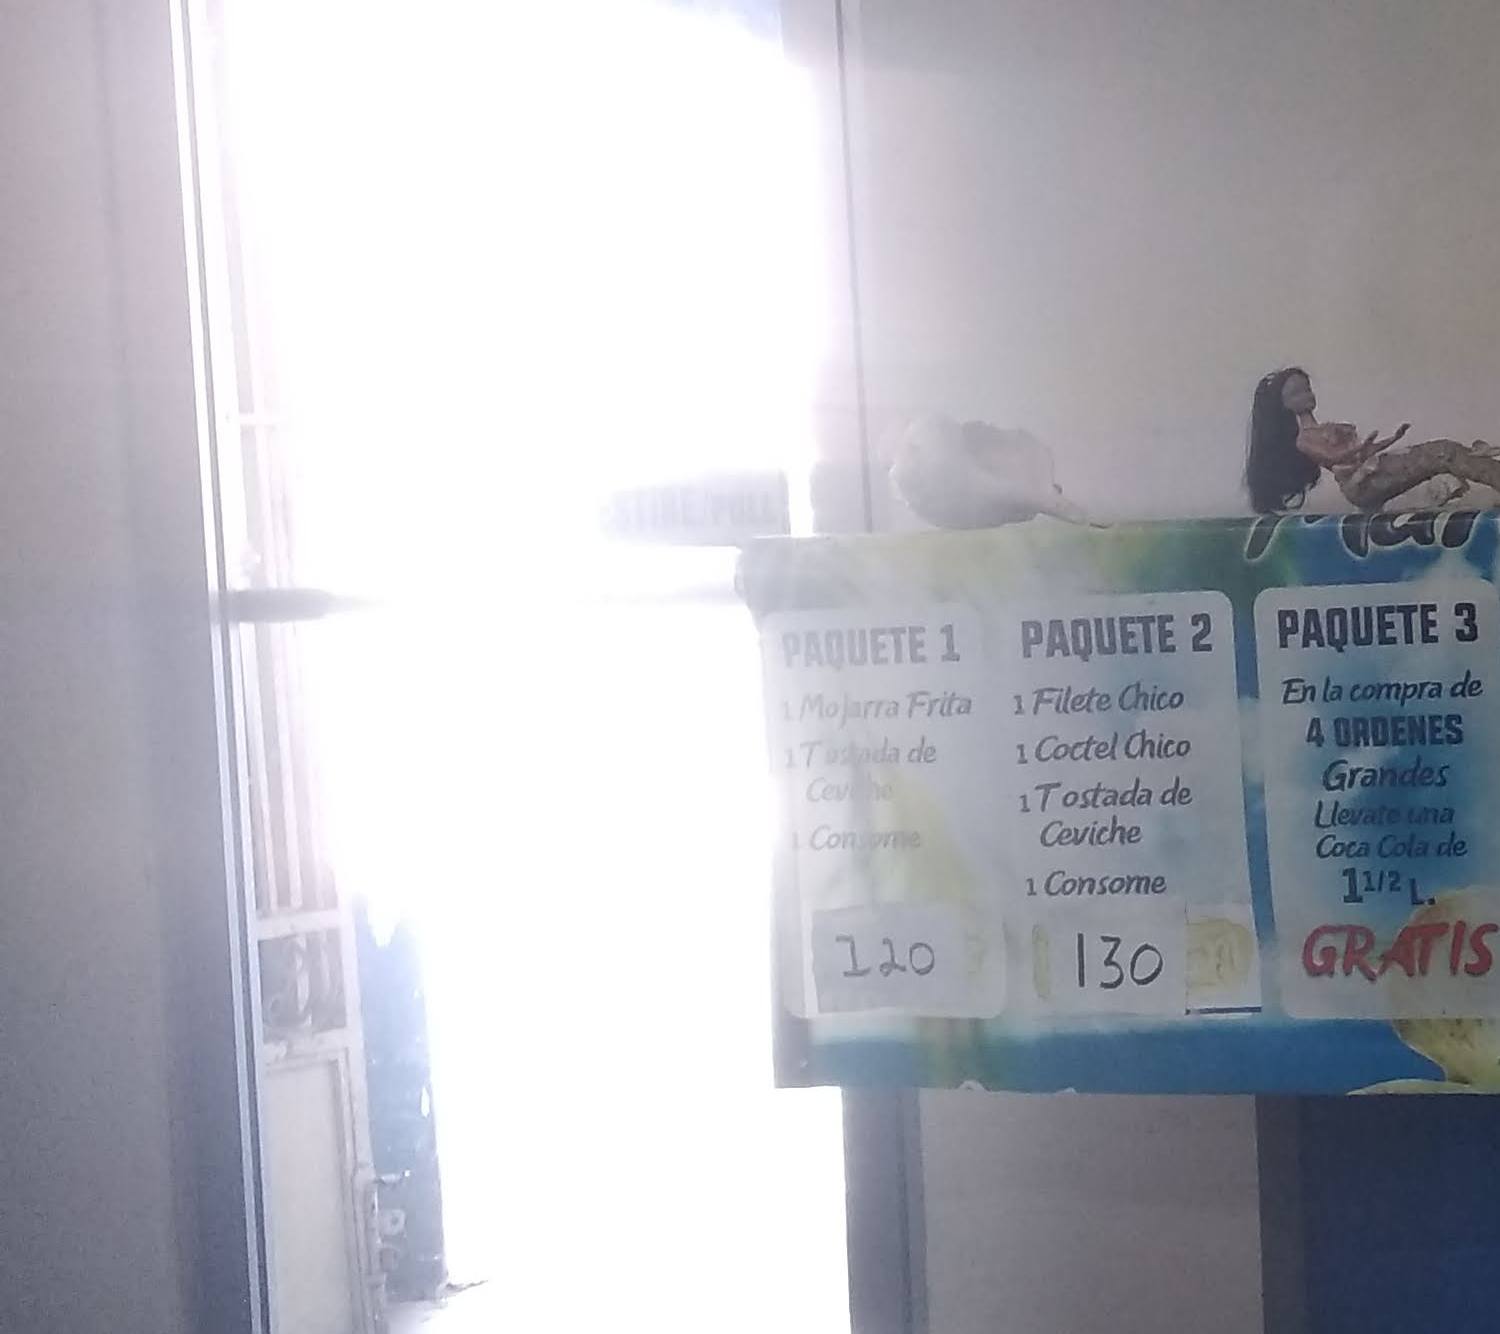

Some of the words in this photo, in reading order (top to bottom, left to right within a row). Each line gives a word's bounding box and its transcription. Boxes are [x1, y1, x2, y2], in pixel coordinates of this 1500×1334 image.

[1021, 615, 1177, 664] PAQUETE
[1191, 612, 1214, 653] 2
[1277, 603, 1438, 653] PAQUETE
[1454, 601, 1480, 644] 3
[782, 624, 928, 670] PAQUETE
[940, 623, 961, 663] 1
[1013, 695, 1026, 716] 1
[1032, 685, 1112, 716] Filete
[1117, 681, 1185, 711] Chico
[1281, 677, 1320, 705] En
[1322, 675, 1346, 703] la
[1349, 677, 1445, 709] compra
[1449, 669, 1484, 698] de
[799, 691, 899, 730] Mojarra
[904, 689, 973, 720] Frita
[906, 734, 938, 764] de
[1016, 743, 1028, 764] 1
[1035, 731, 1118, 764] Coctel
[1122, 728, 1192, 761] Chico
[1306, 719, 1325, 748] 4
[1332, 714, 1465, 748] ORDENES
[1322, 756, 1450, 791] Grandes
[1019, 793, 1031, 814] 1
[1035, 777, 1154, 813] Tostada
[1159, 776, 1193, 808] de
[1040, 814, 1143, 848] Ceviche
[1314, 800, 1396, 829] Llevate
[1406, 805, 1454, 827] una
[1315, 835, 1370, 859] Coca
[1375, 832, 1434, 858] Cola
[1437, 830, 1469, 858] de
[1026, 877, 1038, 897] 1
[1044, 870, 1168, 897] Consome
[835, 933, 936, 980] 120
[1074, 932, 1165, 990] 130
[1302, 921, 1500, 982] GRATIS
